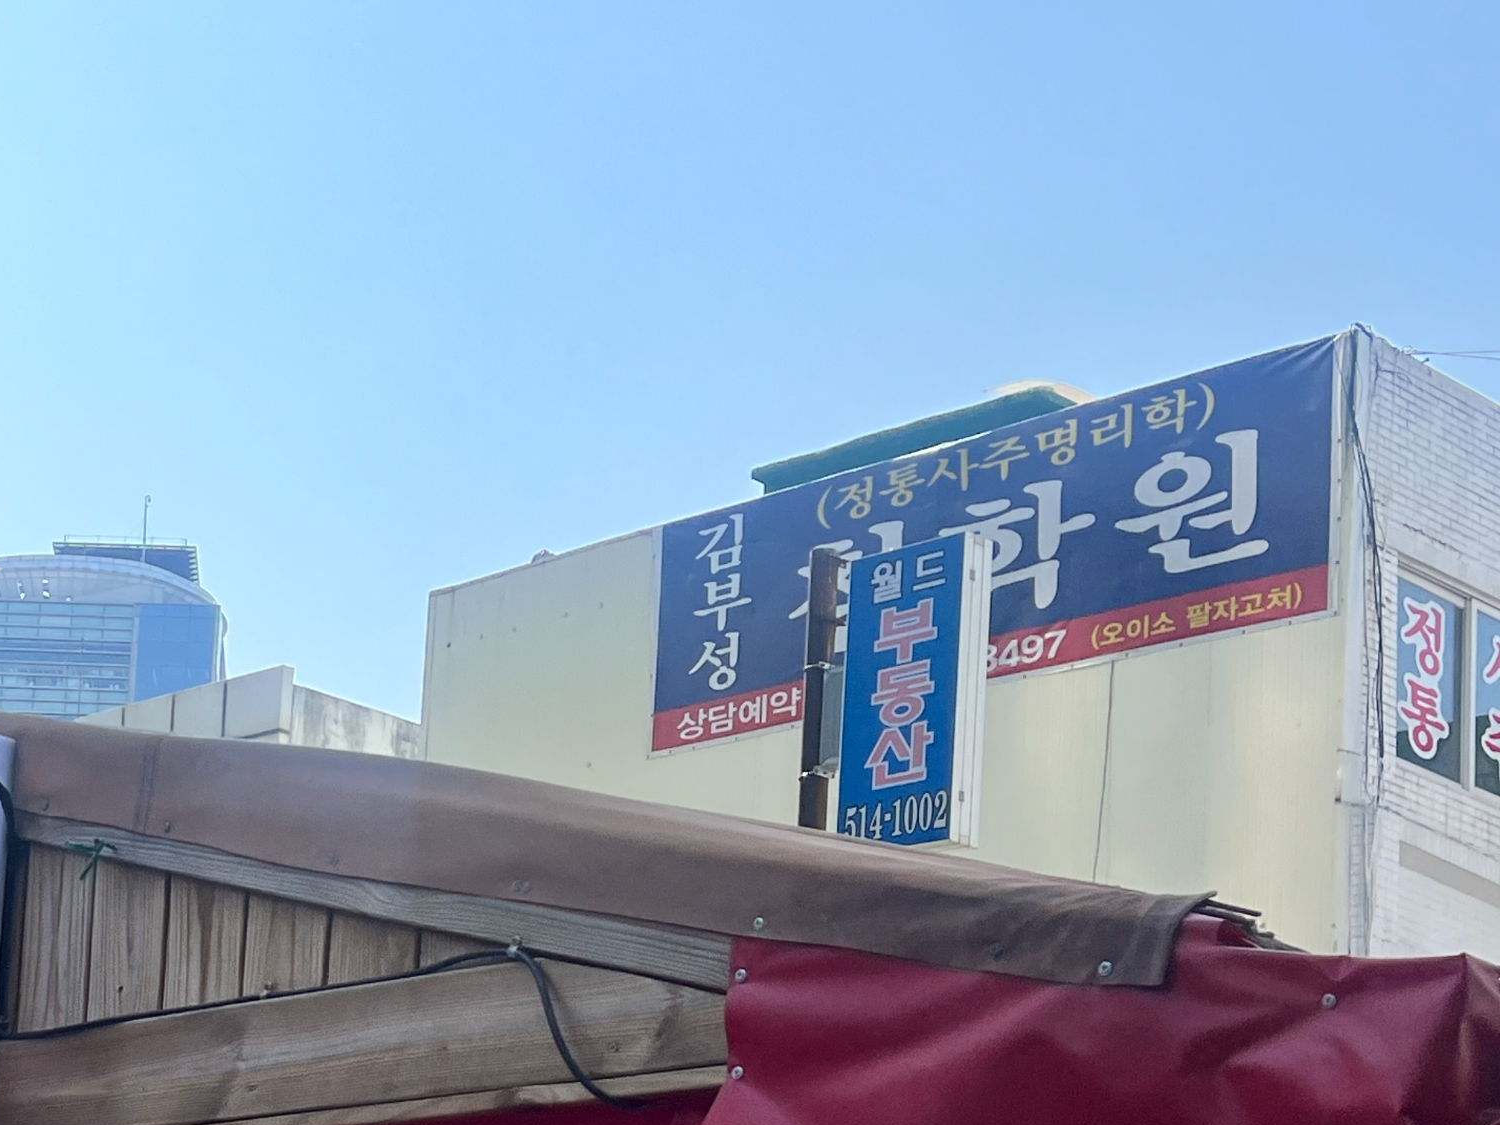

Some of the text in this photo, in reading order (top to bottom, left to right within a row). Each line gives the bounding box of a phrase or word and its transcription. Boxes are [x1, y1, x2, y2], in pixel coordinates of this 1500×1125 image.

[817, 382, 1216, 529] (정통사주명리학)
[688, 513, 752, 691] 김부성
[871, 551, 946, 604] 월드
[677, 687, 802, 740] 상담예약
[863, 597, 938, 791] 부동산
[1399, 599, 1448, 757] 정통
[844, 791, 949, 840] 514-1002
